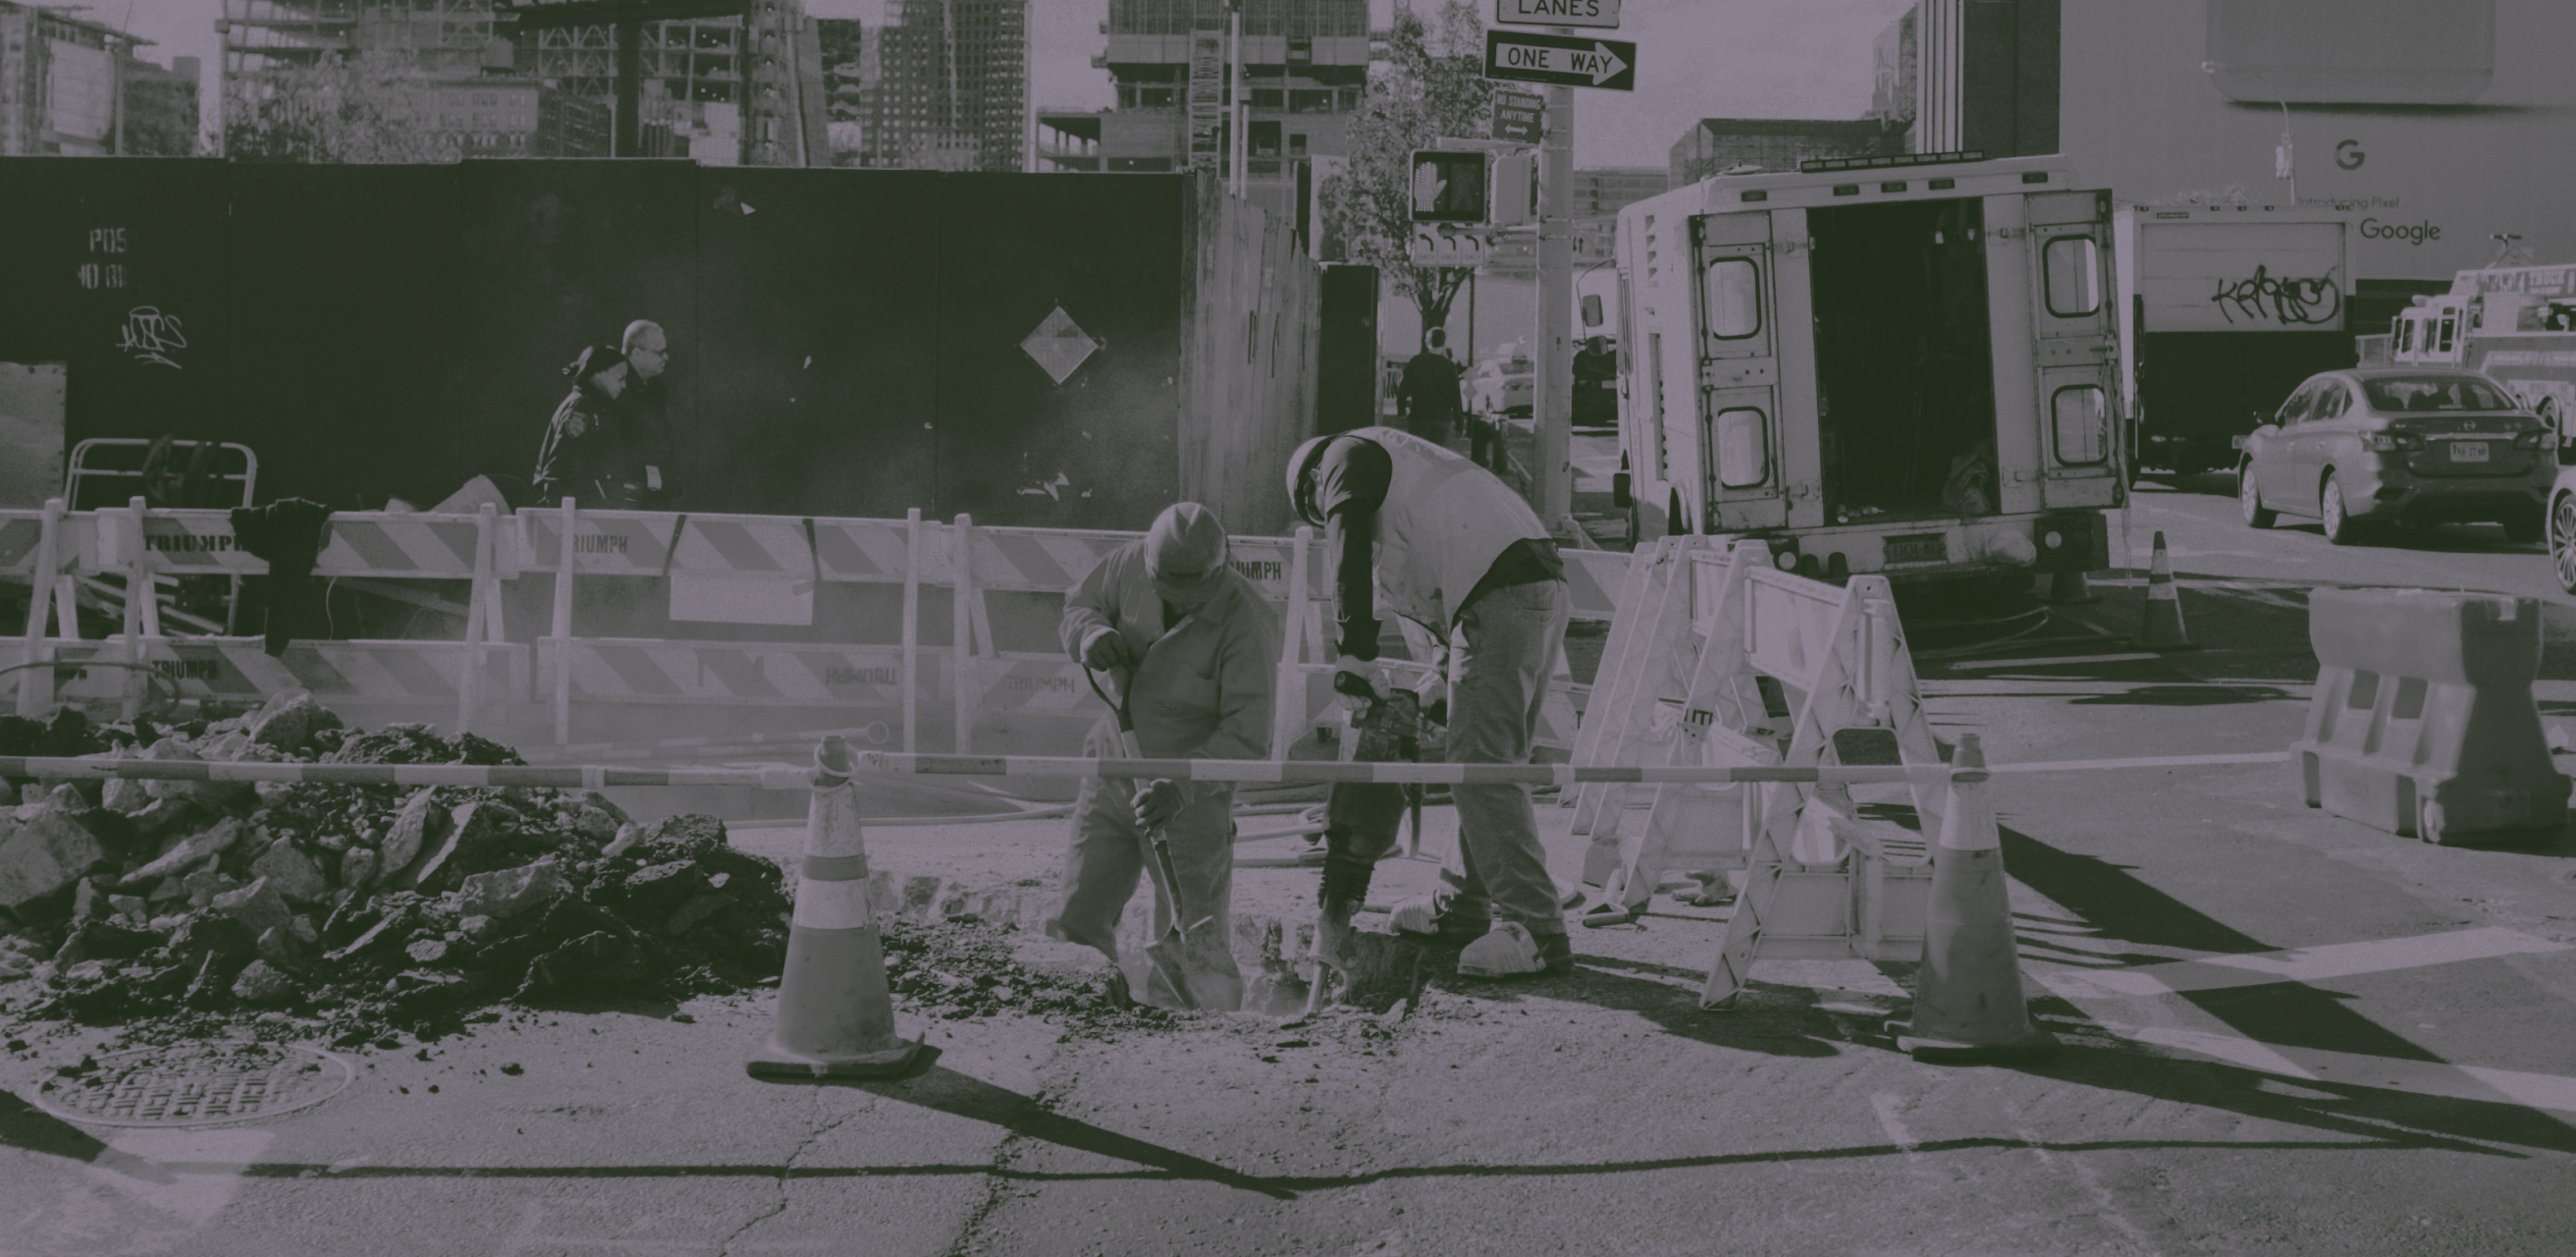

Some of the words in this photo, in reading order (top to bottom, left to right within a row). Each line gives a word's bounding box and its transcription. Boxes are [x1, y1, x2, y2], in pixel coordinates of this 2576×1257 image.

[1519, 0, 1599, 17] LANES
[1508, 47, 1549, 68] ONE
[1571, 52, 1613, 74] WAY
[1497, 93, 1507, 105] NO
[1508, 95, 1541, 110] STANDING
[1500, 109, 1534, 123] ANYTIME
[2334, 138, 2366, 171] G
[2371, 196, 2399, 208] Pixel
[2360, 217, 2442, 246] Google
[573, 534, 629, 554] RIUMPH
[152, 659, 218, 680] TRIUMPH
[1005, 674, 1075, 693] TRIUMPH
